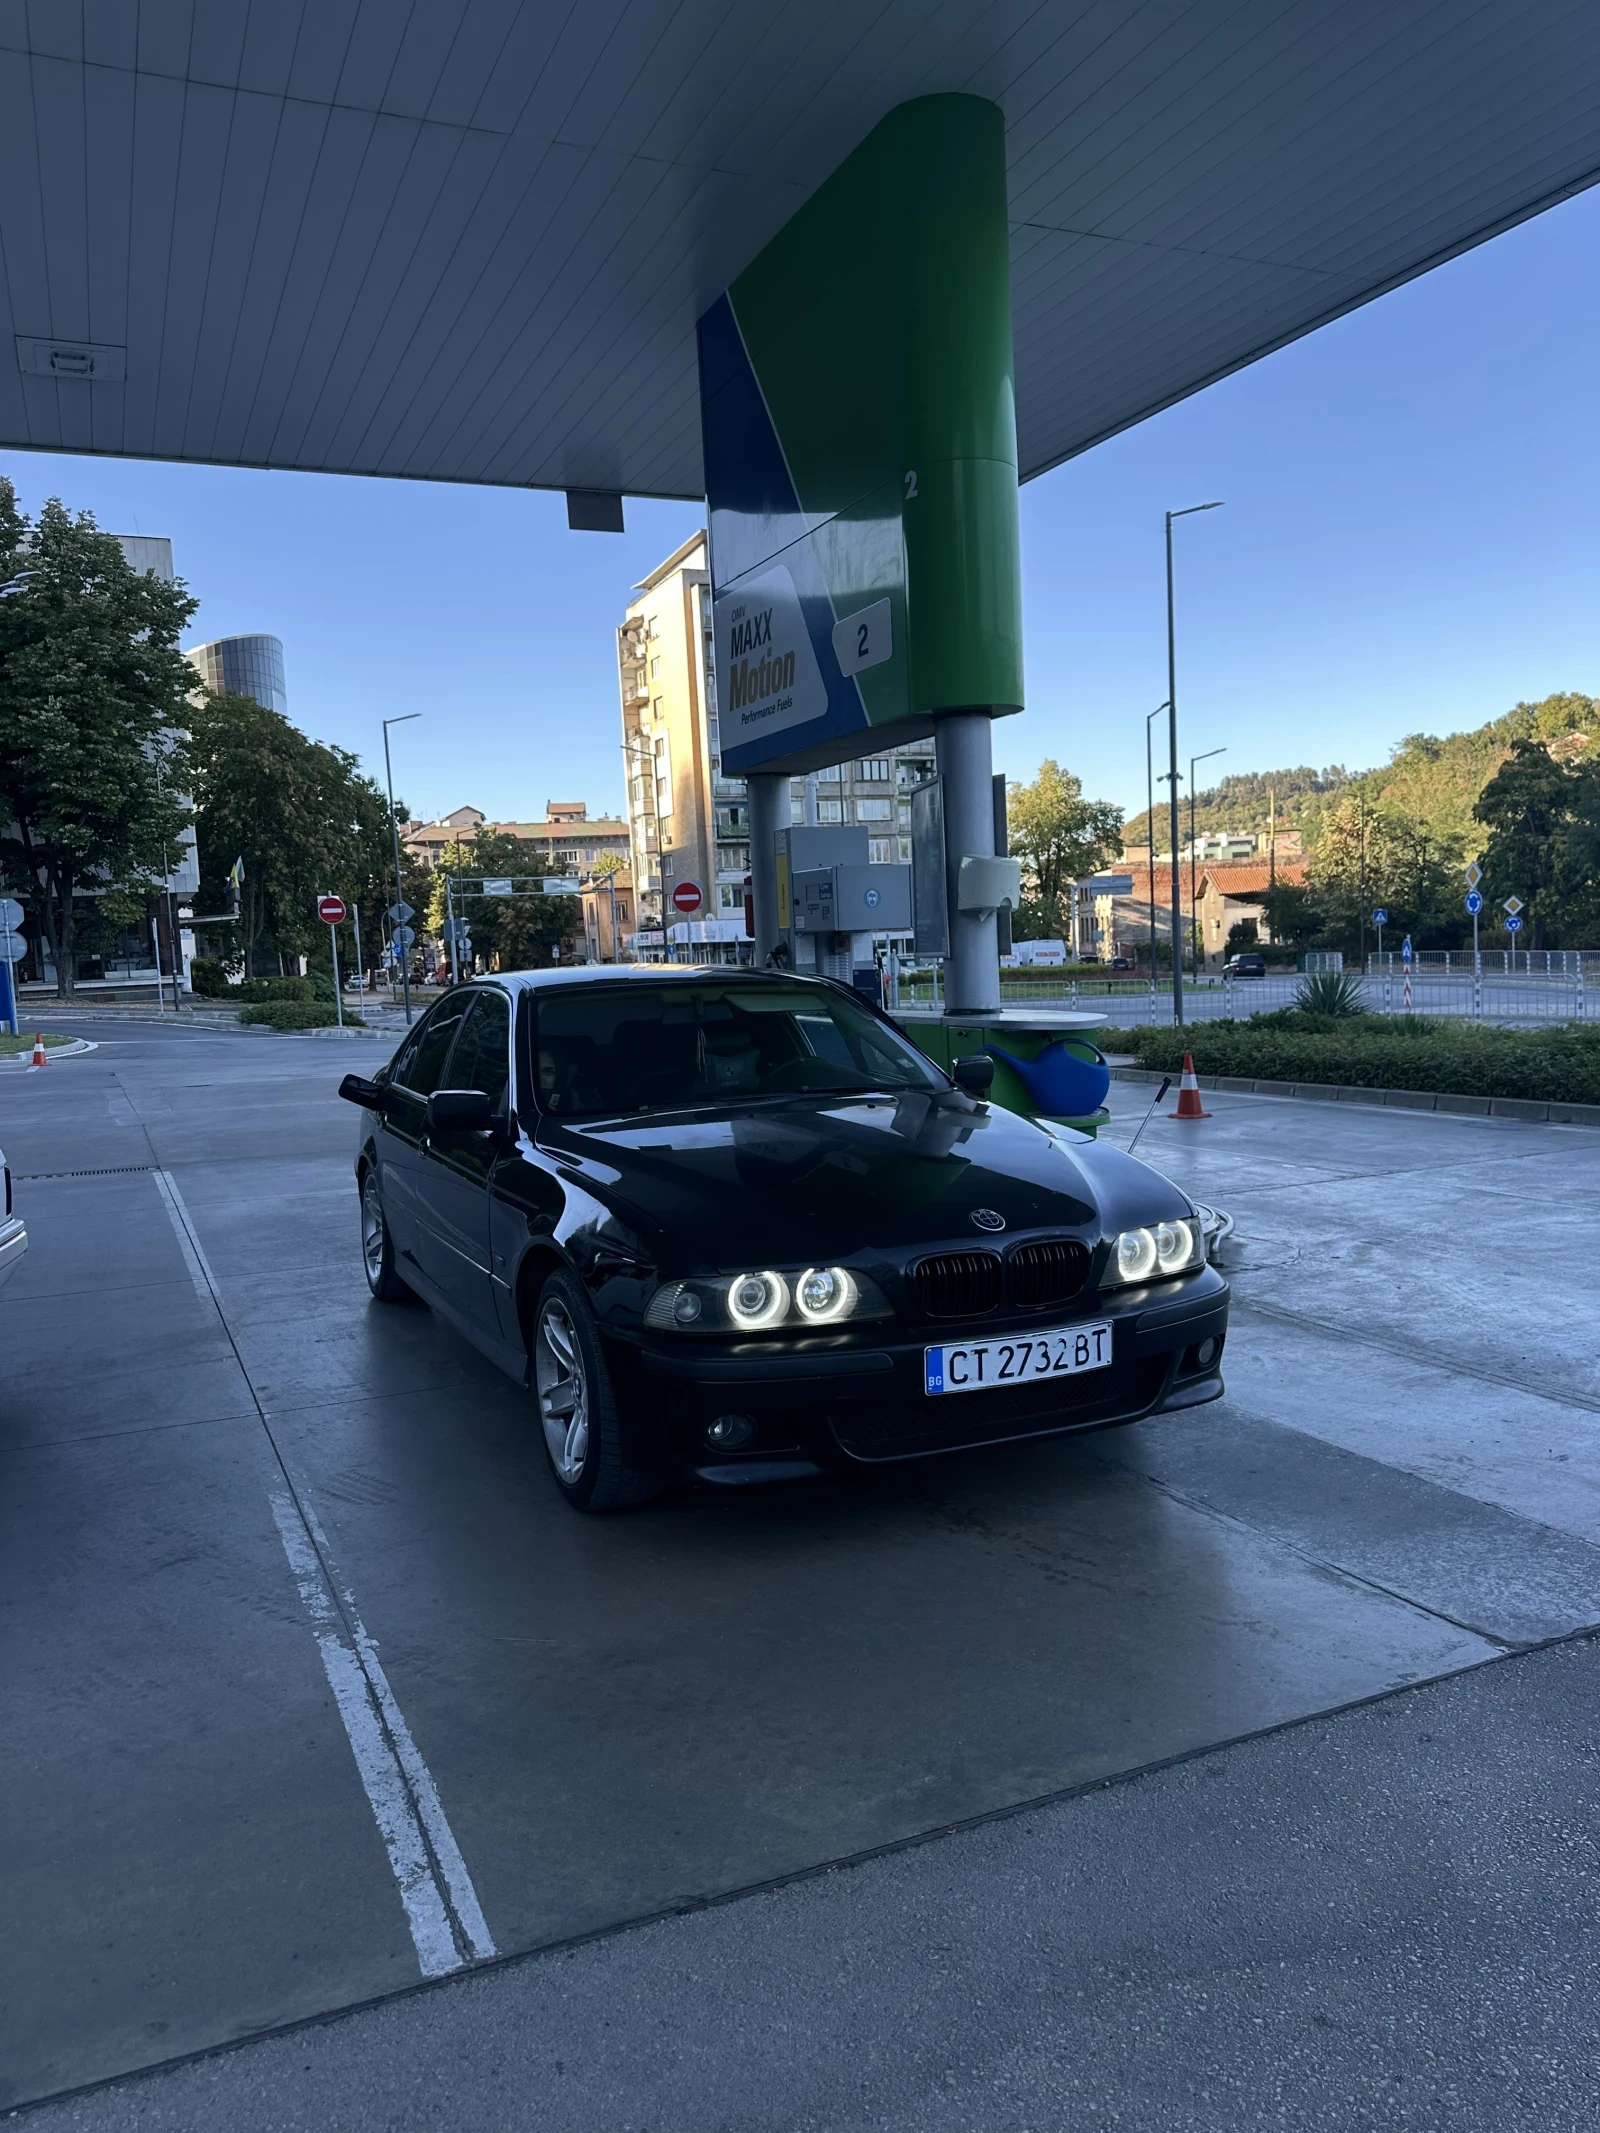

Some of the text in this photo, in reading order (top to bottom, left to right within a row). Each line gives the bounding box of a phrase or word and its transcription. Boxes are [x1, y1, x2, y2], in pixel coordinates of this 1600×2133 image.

[904, 470, 919, 500] 2
[732, 604, 747, 622] OMV
[731, 608, 773, 659] MAXX
[857, 623, 869, 658] 2
[729, 647, 796, 712] Motion
[741, 695, 793, 726] Performance Fuels
[949, 1328, 1107, 1385] CT 2732 BT
[928, 1376, 942, 1387] BG
